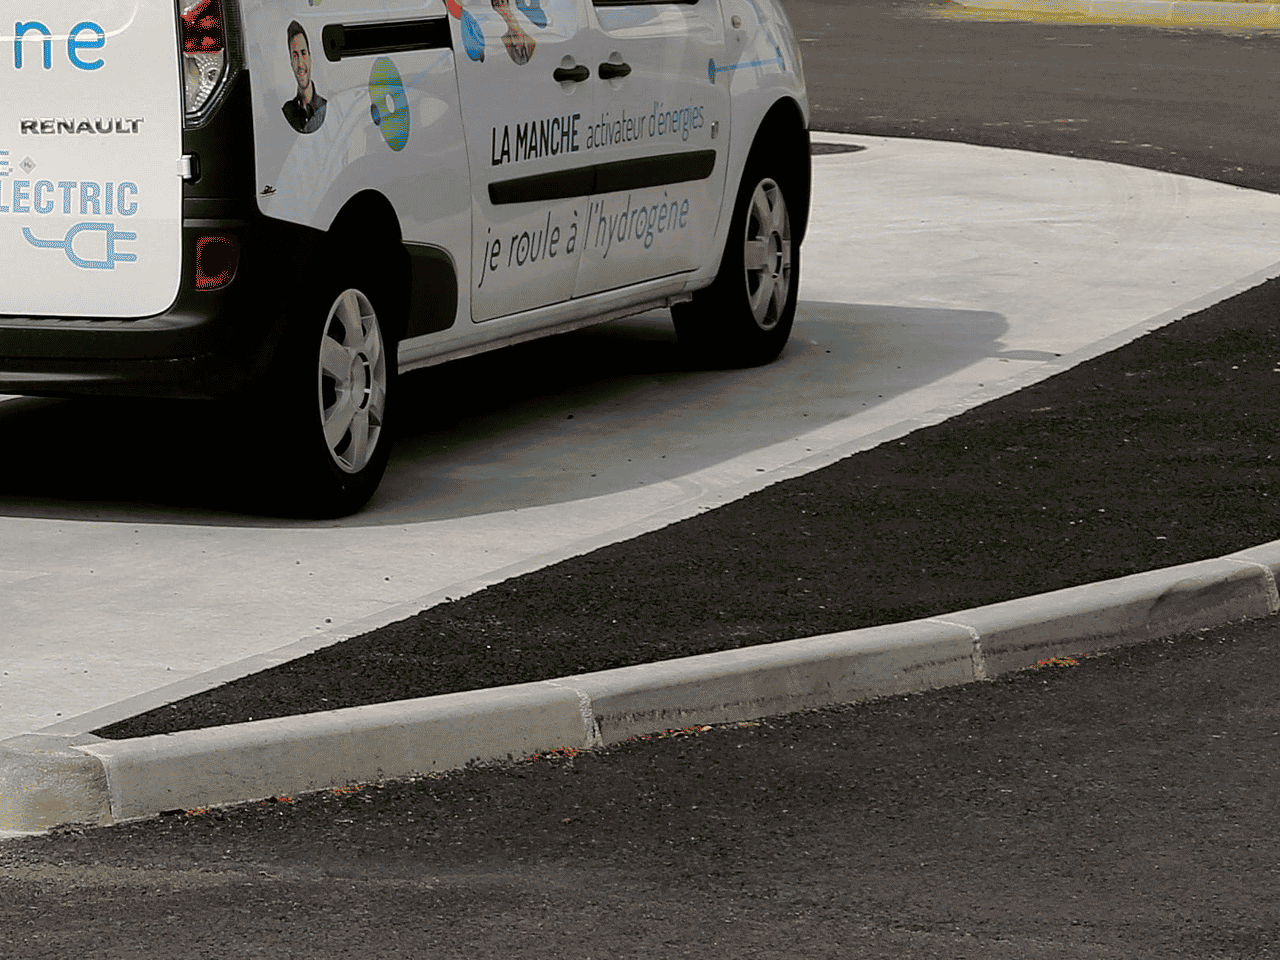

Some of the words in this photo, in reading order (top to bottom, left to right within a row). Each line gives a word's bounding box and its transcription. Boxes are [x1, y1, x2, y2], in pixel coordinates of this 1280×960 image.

[20, 116, 145, 135] RENAULT
[491, 124, 511, 166] LA
[515, 113, 581, 162] MANCHE
[586, 109, 646, 150] activateur
[648, 100, 705, 142] d'énergies
[478, 227, 501, 289] je
[508, 210, 560, 268] roule
[566, 209, 578, 255] à
[583, 190, 689, 260] l'hydrogène
